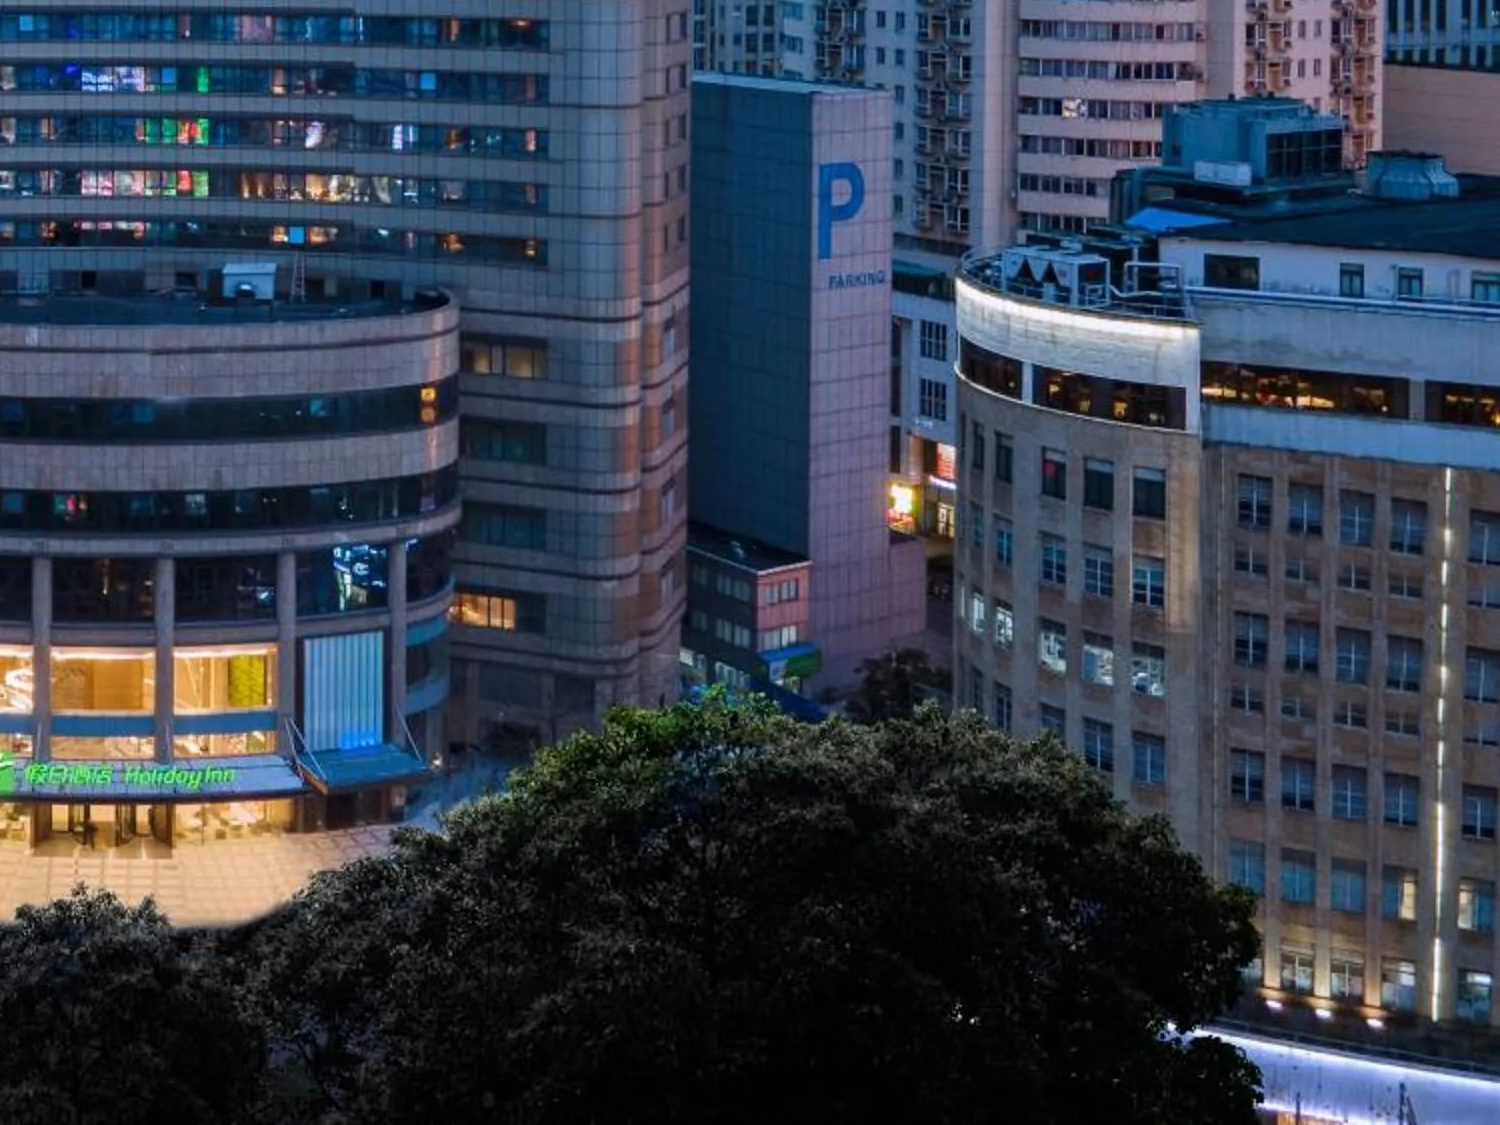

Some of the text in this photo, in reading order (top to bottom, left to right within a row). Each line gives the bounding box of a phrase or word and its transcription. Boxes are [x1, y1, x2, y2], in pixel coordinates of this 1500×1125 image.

[818, 162, 865, 260] P
[828, 271, 886, 291] PARKING
[123, 764, 238, 789] Holiday Inn
